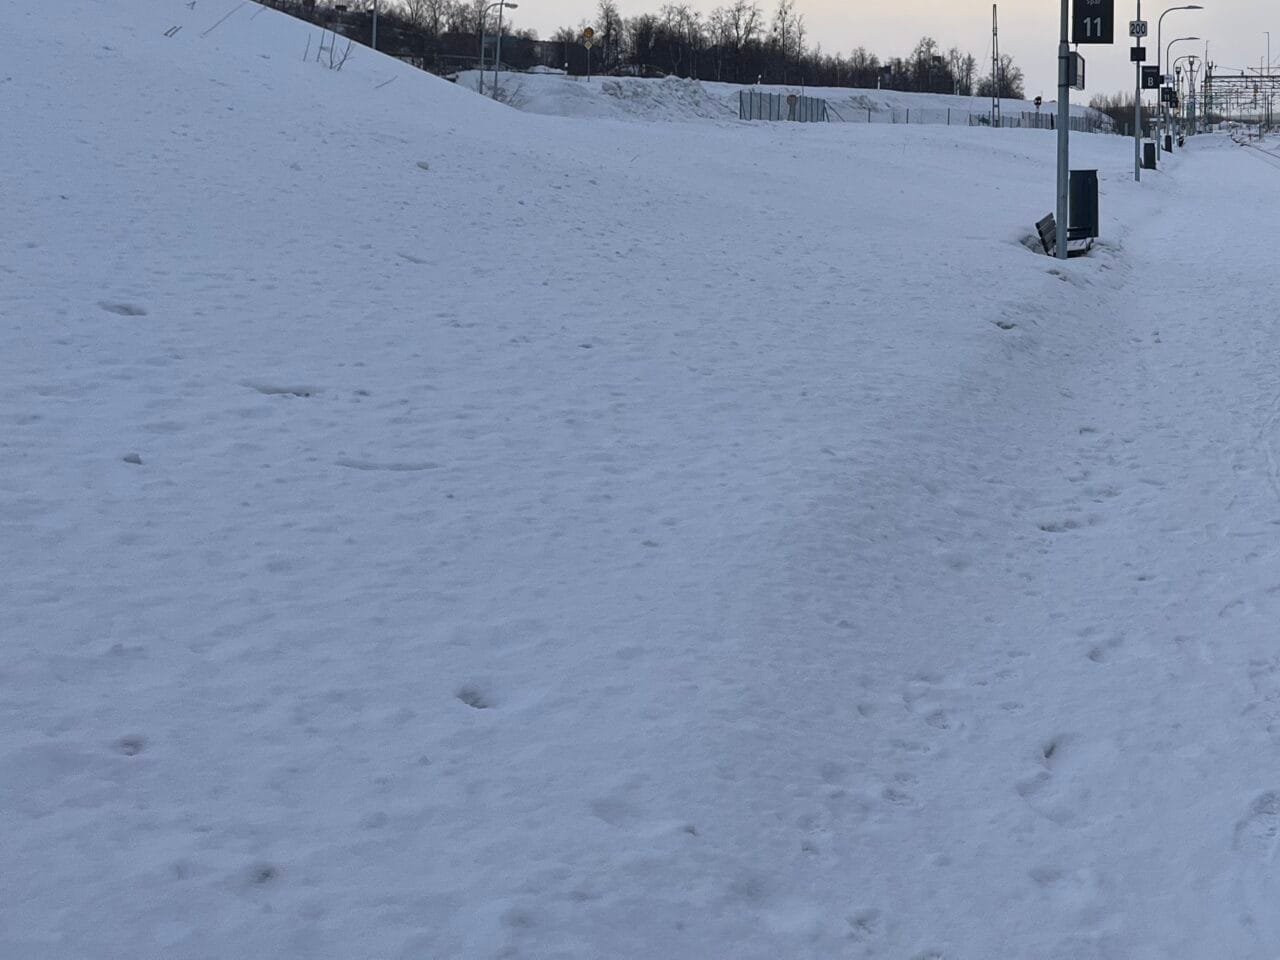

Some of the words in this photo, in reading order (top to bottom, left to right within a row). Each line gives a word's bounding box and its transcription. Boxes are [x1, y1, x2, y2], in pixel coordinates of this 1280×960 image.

[1083, 16, 1102, 37] 11
[1130, 23, 1146, 35] 200
[1147, 77, 1154, 86] B
